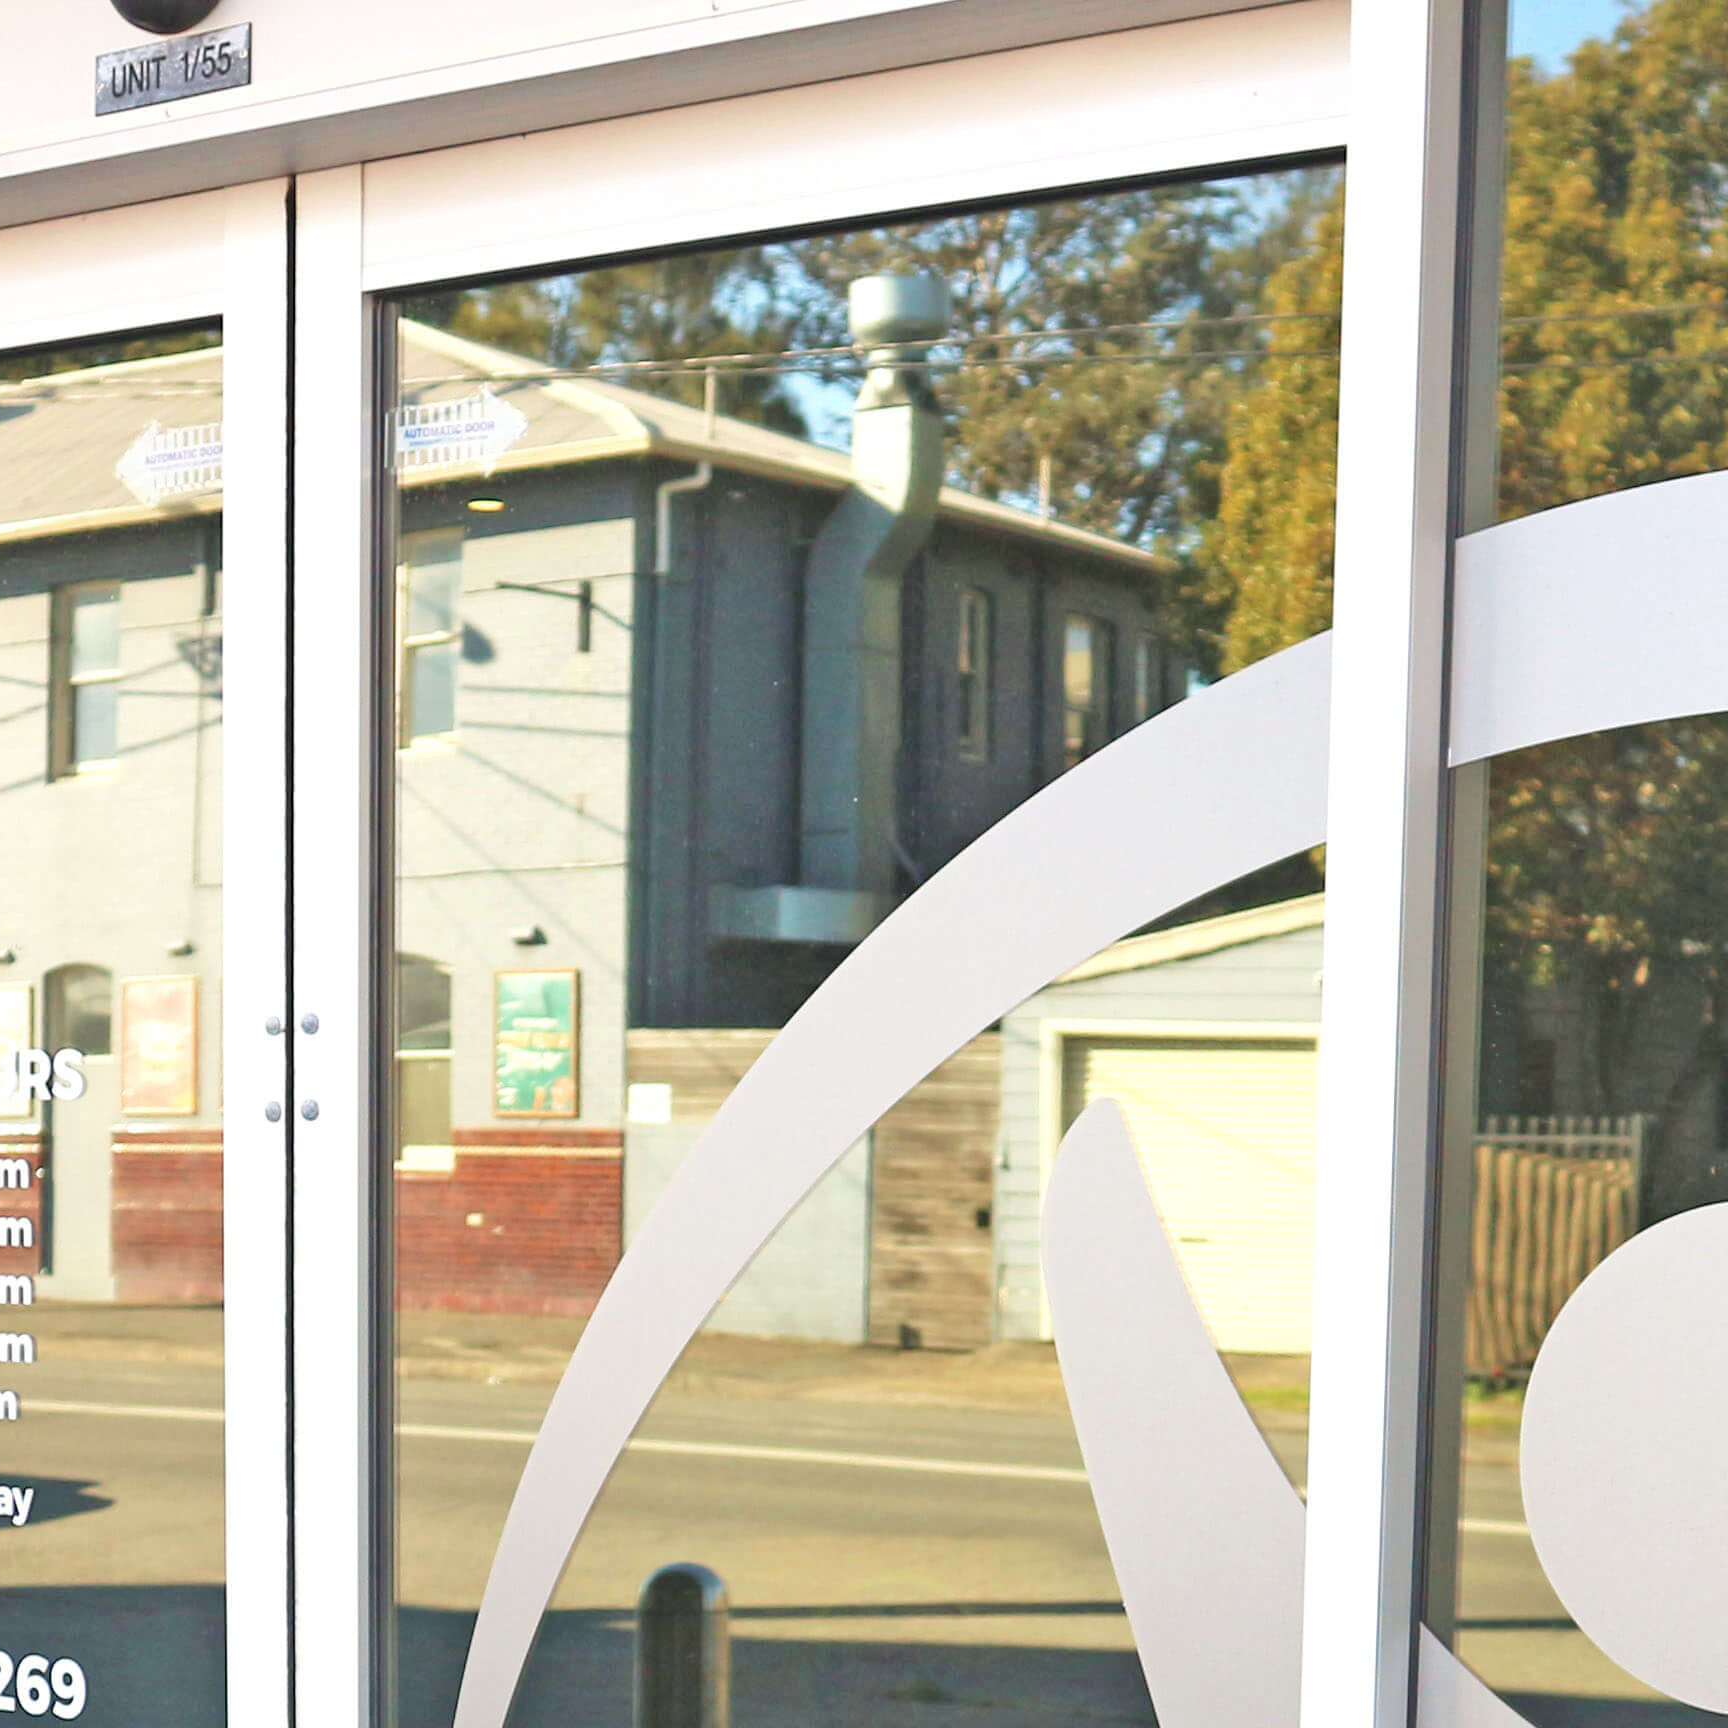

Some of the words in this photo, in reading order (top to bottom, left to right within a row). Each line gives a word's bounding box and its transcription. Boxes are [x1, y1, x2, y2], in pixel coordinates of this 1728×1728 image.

[111, 56, 166, 98] UNIT
[180, 42, 232, 82] 1/55
[404, 423, 462, 439] AUTOMATIC
[465, 420, 496, 433] DOOR
[145, 447, 198, 465] AUTOMATIC
